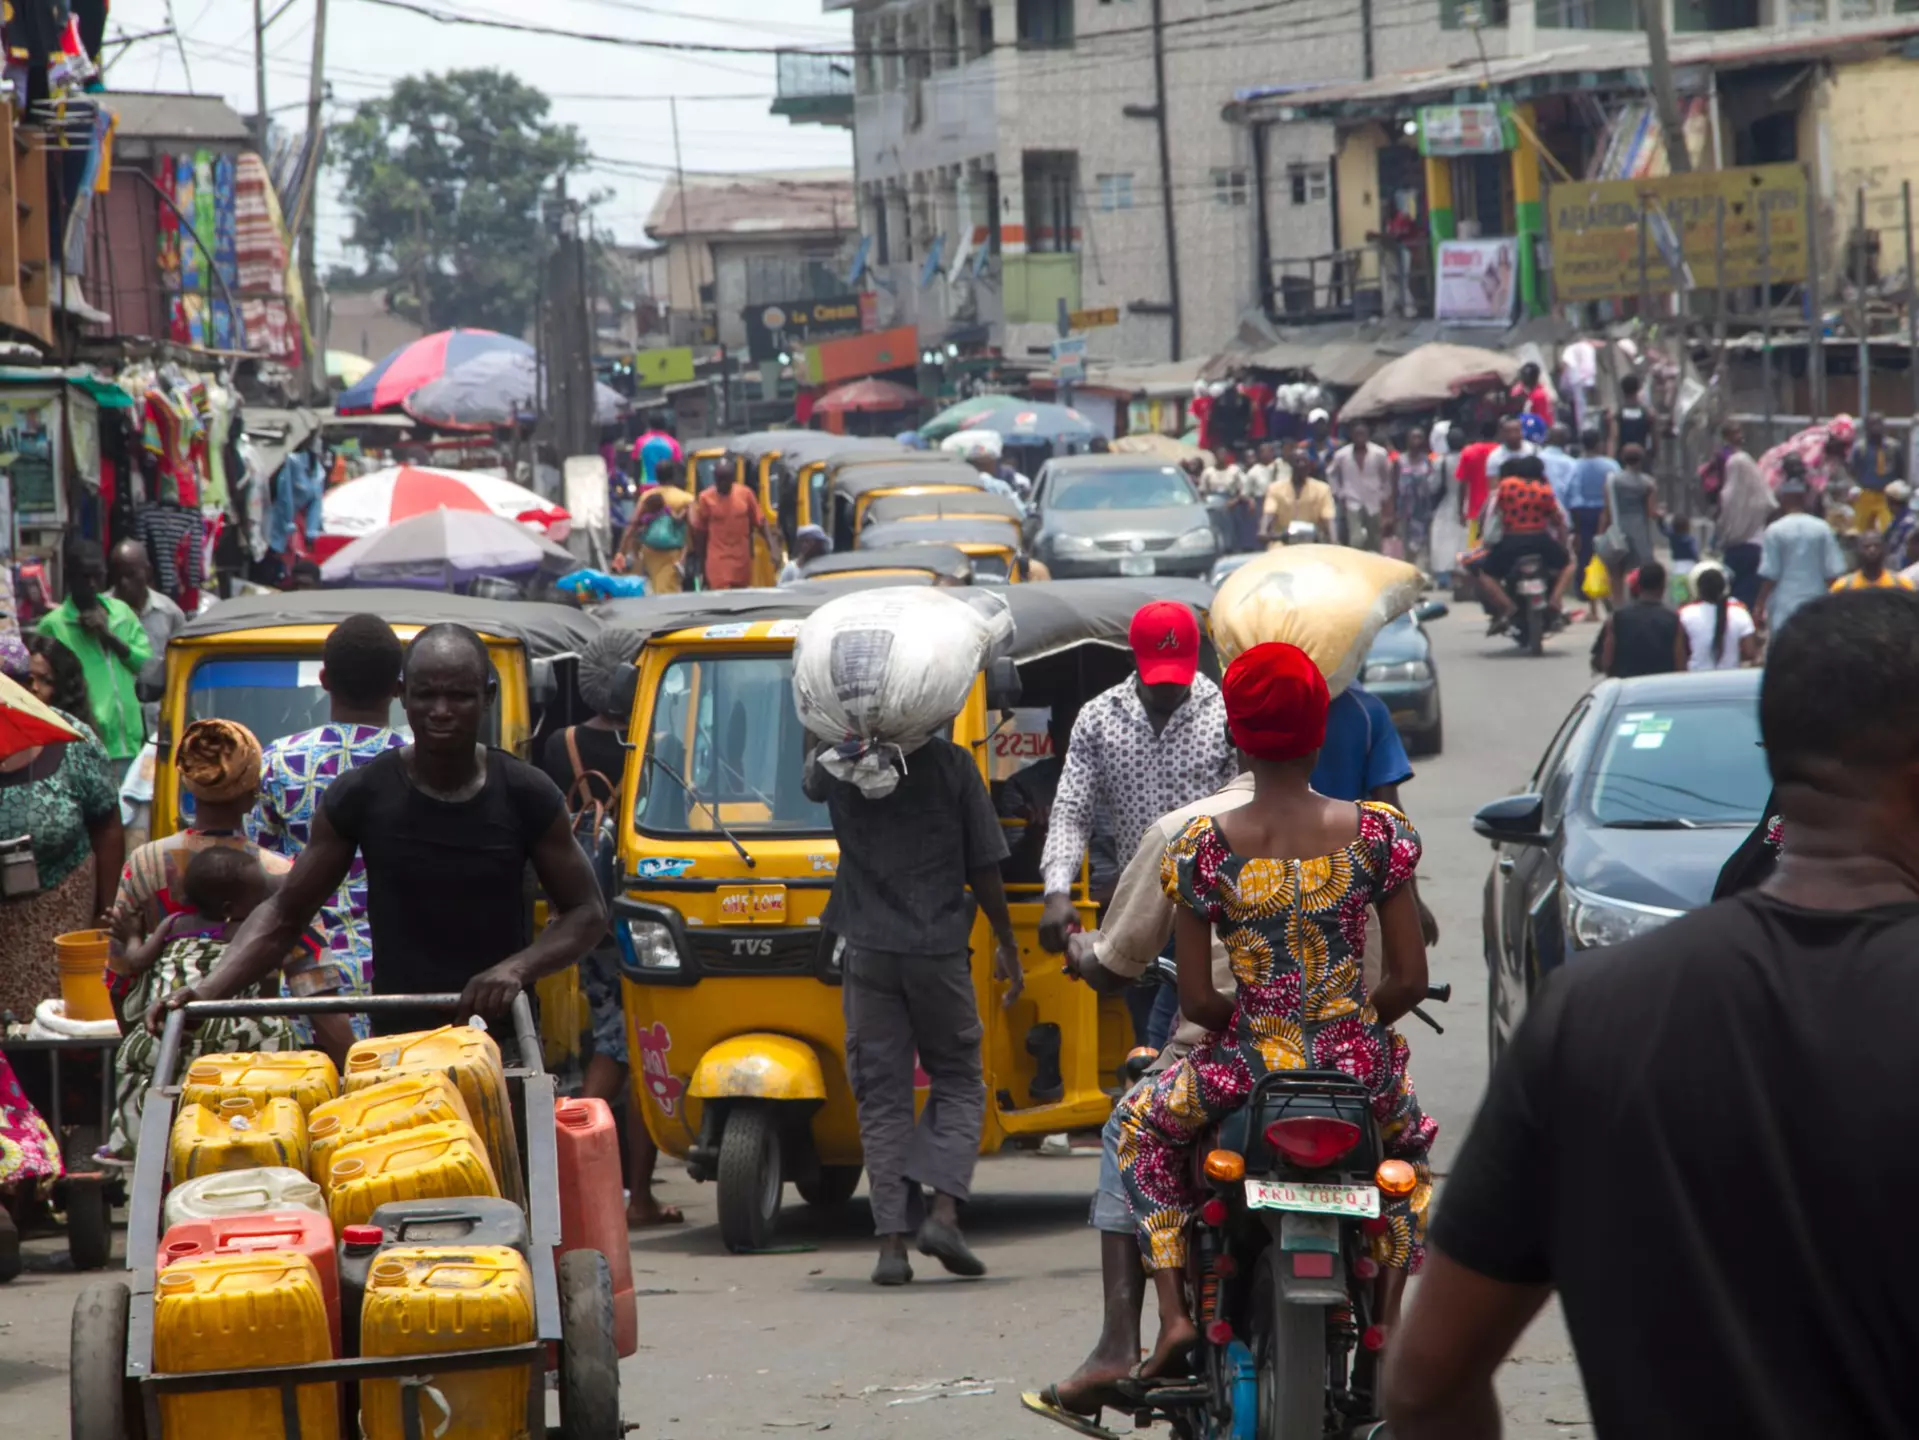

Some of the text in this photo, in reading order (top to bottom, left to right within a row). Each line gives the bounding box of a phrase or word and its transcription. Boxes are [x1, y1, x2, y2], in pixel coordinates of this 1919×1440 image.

[722, 893, 785, 914] ONE LOVE
[731, 938, 774, 956] TVS
